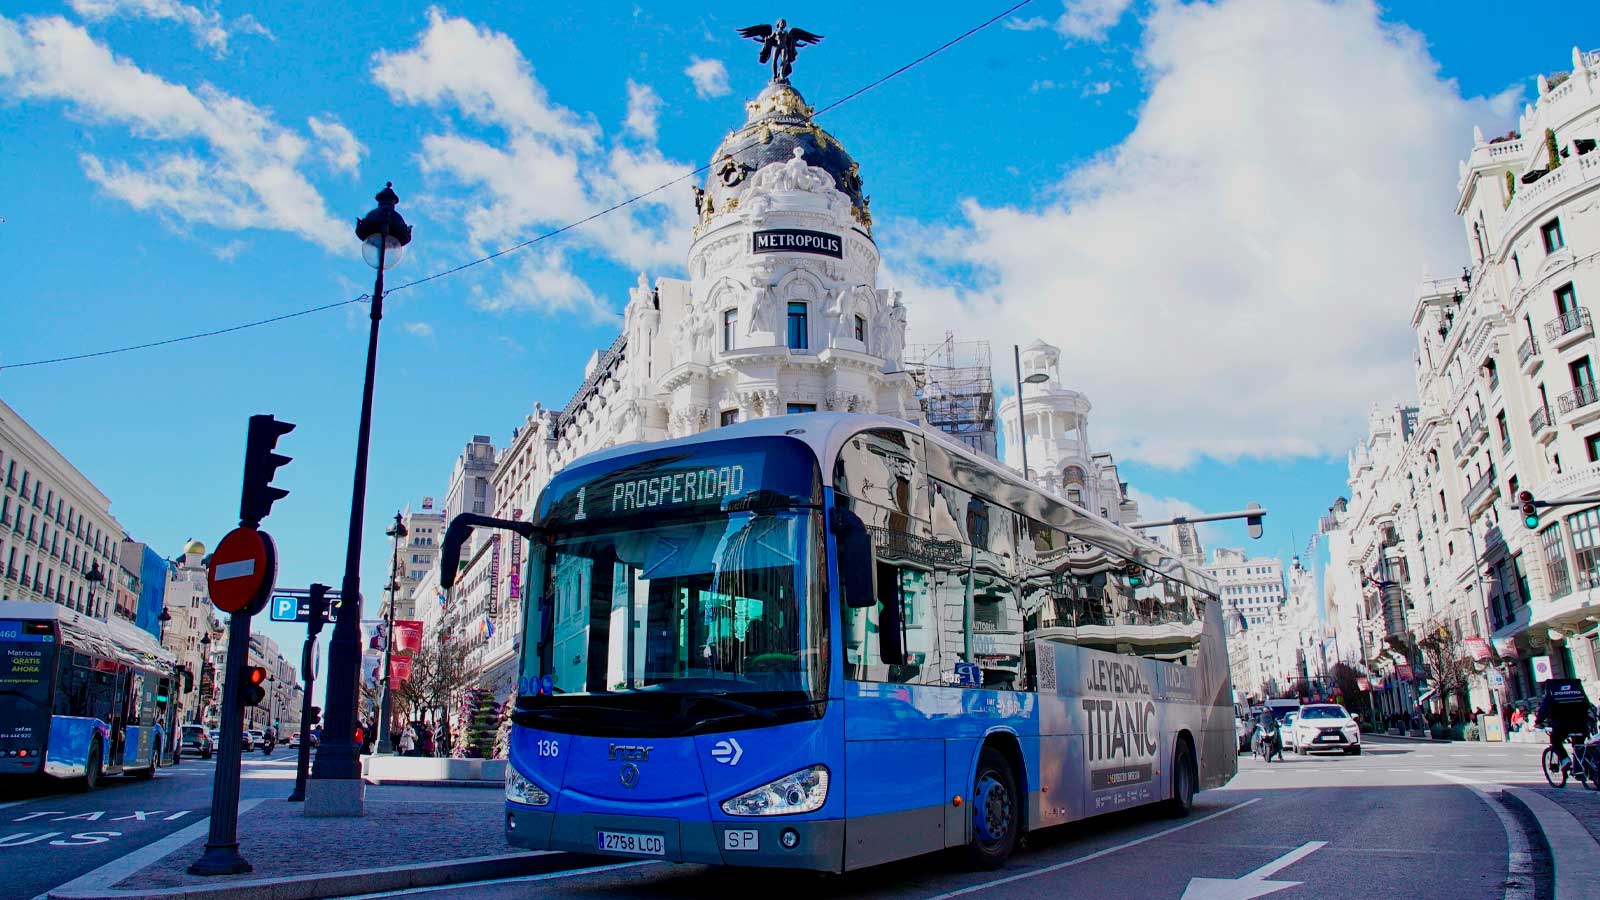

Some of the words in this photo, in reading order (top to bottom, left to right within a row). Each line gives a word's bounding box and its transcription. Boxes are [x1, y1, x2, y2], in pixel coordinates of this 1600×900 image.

[758, 234, 839, 252] METROPOLIS
[574, 486, 587, 520] 1
[612, 465, 744, 512] PROSPERIDAD
[279, 601, 291, 616] P
[1092, 659, 1143, 694] LEYENDA
[1083, 700, 1157, 762] TITANIC
[537, 740, 559, 757] 136
[12, 811, 192, 821] TAXI
[606, 835, 635, 850] 2758
[638, 839, 661, 852] LCD
